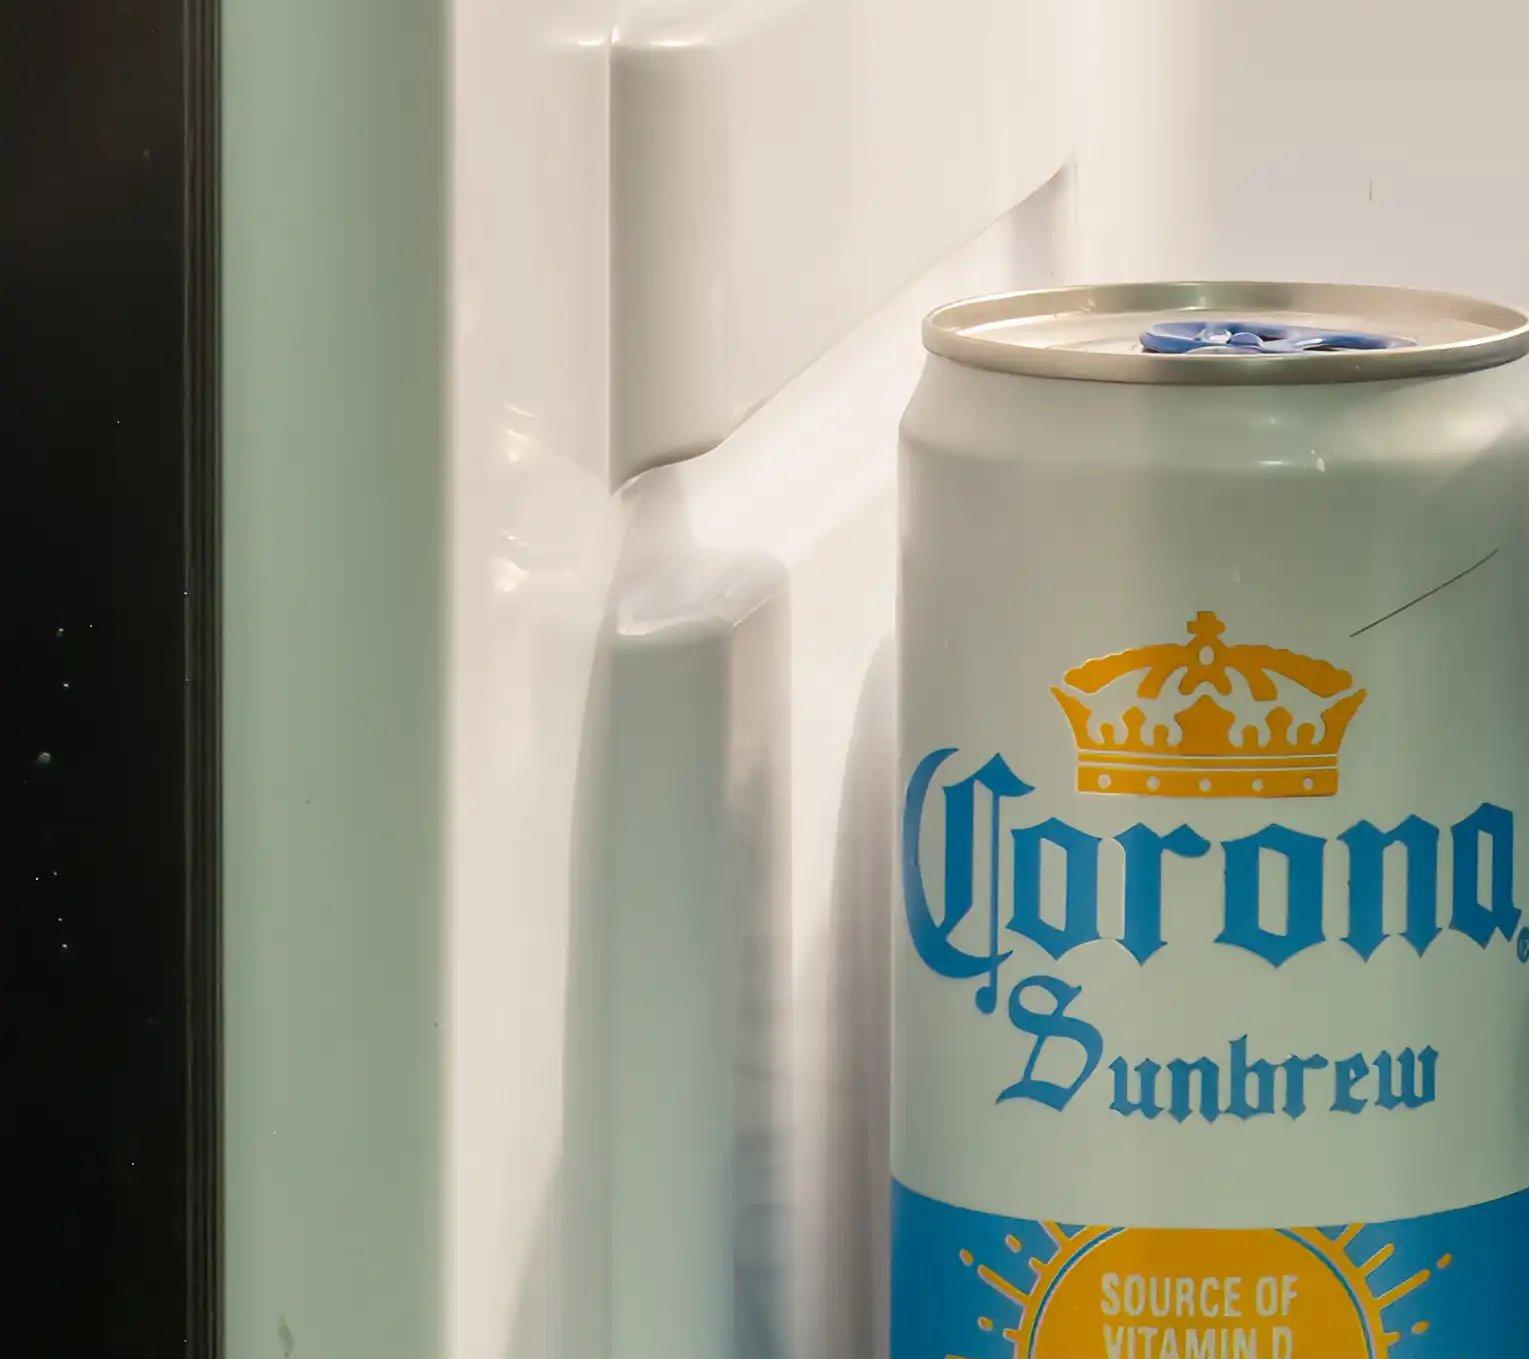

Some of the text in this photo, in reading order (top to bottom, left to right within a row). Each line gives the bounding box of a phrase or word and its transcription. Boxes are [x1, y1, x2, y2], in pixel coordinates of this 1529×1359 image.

[902, 746, 1522, 1012] Corona
[995, 975, 1439, 1123] Sunbrew
[1100, 1272, 1300, 1320] SOURCE OF
